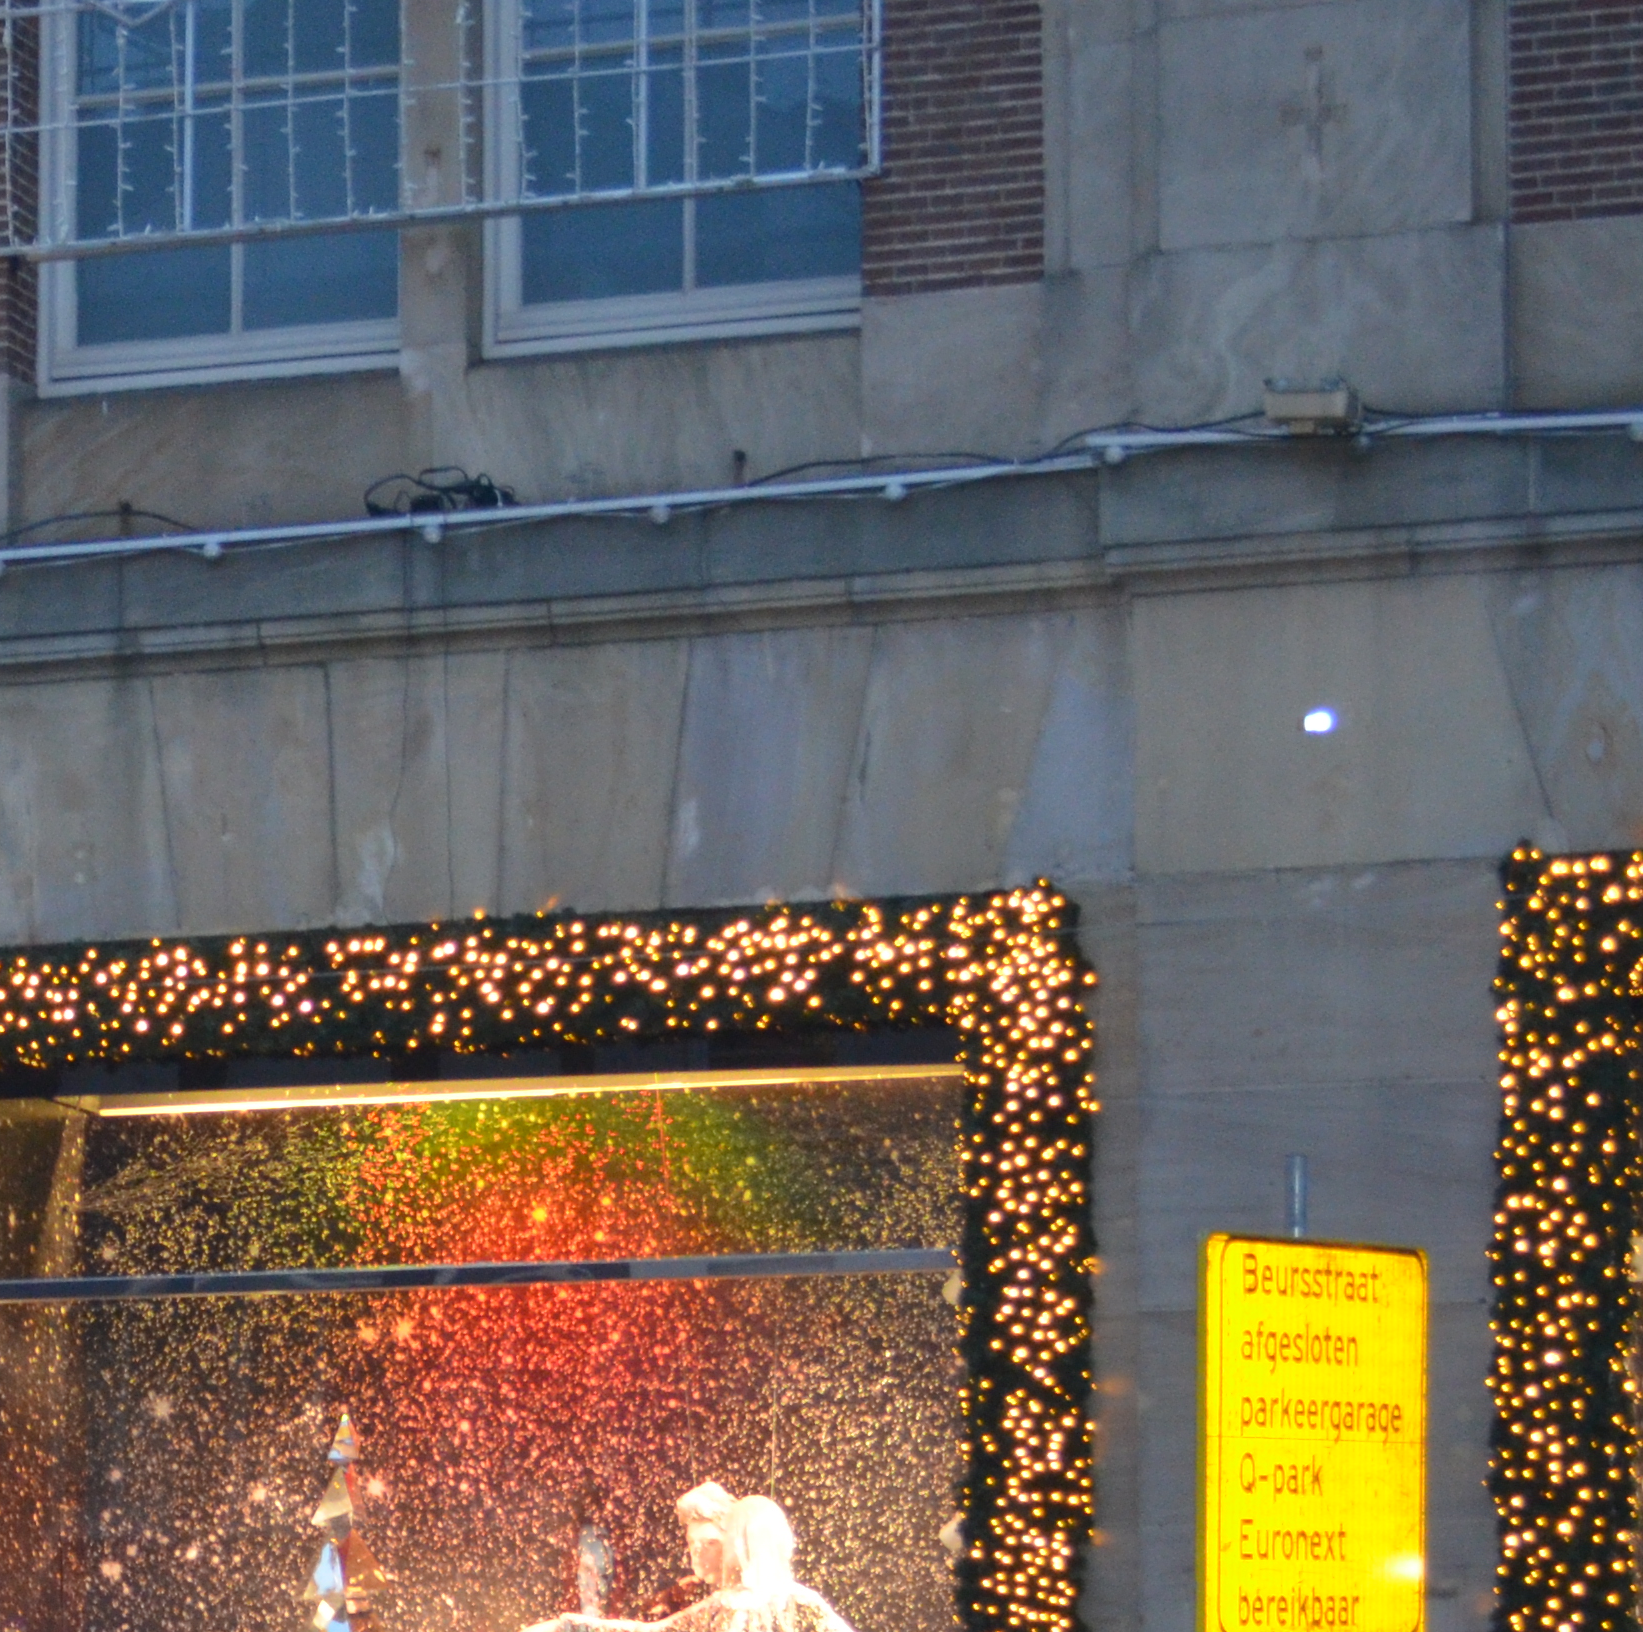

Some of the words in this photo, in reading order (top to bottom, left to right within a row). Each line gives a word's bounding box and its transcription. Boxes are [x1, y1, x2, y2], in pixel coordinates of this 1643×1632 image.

[1242, 1252, 1380, 1304] Beursstraat
[1240, 1322, 1360, 1375] afgesloten
[1240, 1389, 1403, 1444] parkeergarage
[1239, 1452, 1324, 1503] Q-park
[1238, 1519, 1347, 1562] Euronext
[1238, 1586, 1360, 1628] bereikbaar
